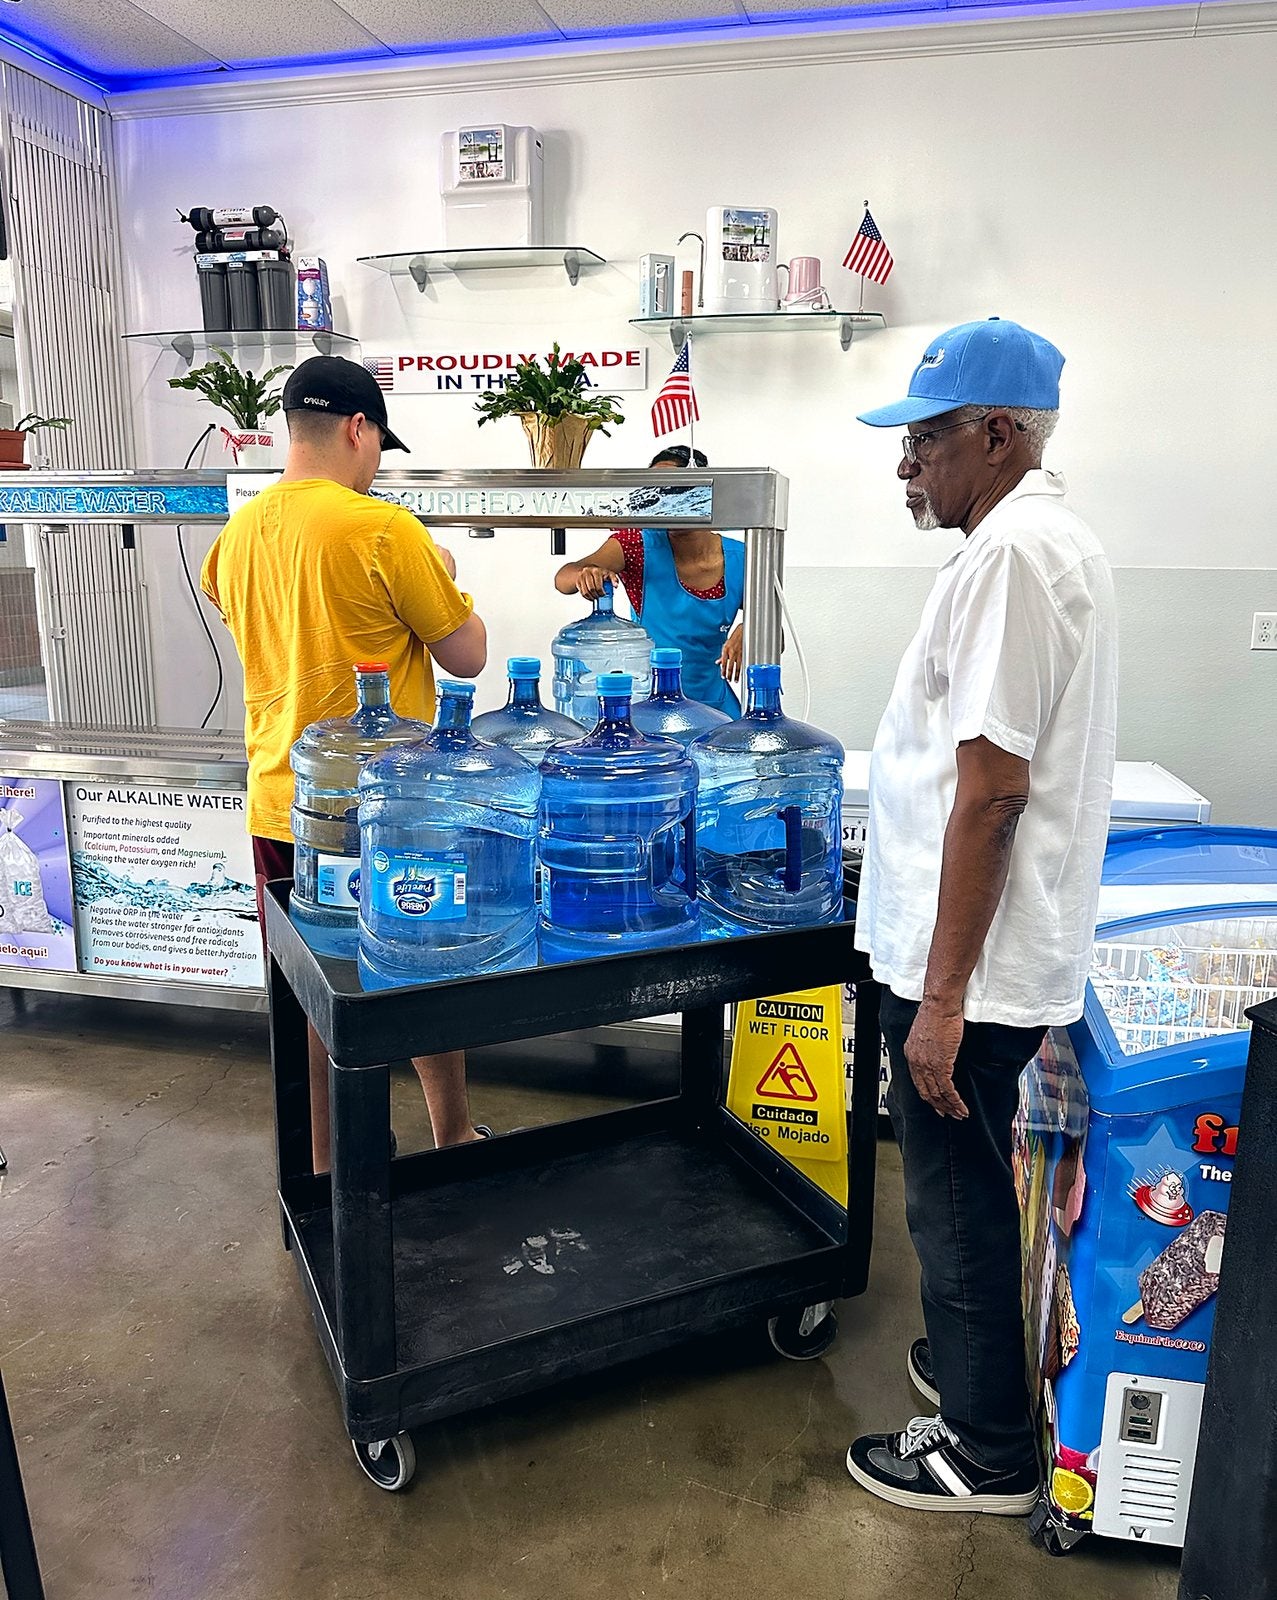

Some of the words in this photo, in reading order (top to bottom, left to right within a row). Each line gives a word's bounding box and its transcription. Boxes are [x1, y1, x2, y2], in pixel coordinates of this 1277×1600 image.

[399, 353, 536, 371] PROUDLY
[544, 351, 640, 369] MADE
[437, 374, 462, 390] IN
[82, 491, 166, 512] WATER
[400, 490, 526, 514] PURIFIED
[6, 786, 34, 798] here!
[76, 787, 103, 802] Our
[107, 789, 184, 807] ALKALINE
[187, 794, 244, 811] WATER
[82, 814, 111, 825] Purified
[112, 817, 120, 825] to
[121, 817, 134, 826] the
[135, 818, 163, 828] highest
[164, 820, 192, 831] quality
[83, 830, 121, 840] Important
[122, 833, 155, 843] minerals
[156, 835, 180, 845] added
[161, 848, 177, 856] and
[114, 855, 127, 864] the
[127, 857, 149, 865] water
[150, 859, 178, 868] oxygen
[179, 860, 197, 868] rich!
[14, 881, 32, 896] ICE
[395, 883, 412, 893] Life
[412, 883, 433, 893] Pure
[89, 905, 122, 916] Negative
[123, 907, 139, 916] ORP
[139, 909, 147, 917] in
[148, 910, 161, 919] the
[161, 912, 184, 920] water
[90, 916, 114, 926] Makes
[114, 918, 127, 927] the
[128, 919, 149, 929] water
[150, 921, 183, 932] stronger
[183, 923, 195, 933] for
[196, 926, 245, 937] antioxidants
[91, 927, 124, 938] Removes
[124, 931, 175, 942] corrosiveness
[175, 935, 191, 943] and
[191, 935, 208, 945] free
[208, 938, 239, 948] radicals
[92, 938, 111, 947] from
[111, 940, 124, 948] our
[125, 941, 152, 951] bodies,
[152, 944, 167, 952] and
[168, 946, 188, 955] gives
[94, 956, 104, 965] Do
[105, 958, 120, 967] you
[121, 959, 142, 969] know
[143, 961, 163, 971] what
[164, 963, 171, 971] is
[172, 963, 180, 972] in
[181, 965, 200, 974] your
[201, 967, 229, 977] water?
[758, 1002, 822, 1020] CAUTION
[749, 1021, 777, 1035] WET
[784, 1024, 829, 1041] FLOOR
[757, 1107, 813, 1123] Cuidado
[778, 1125, 830, 1144] Mojado
[1200, 1164, 1232, 1182] The
